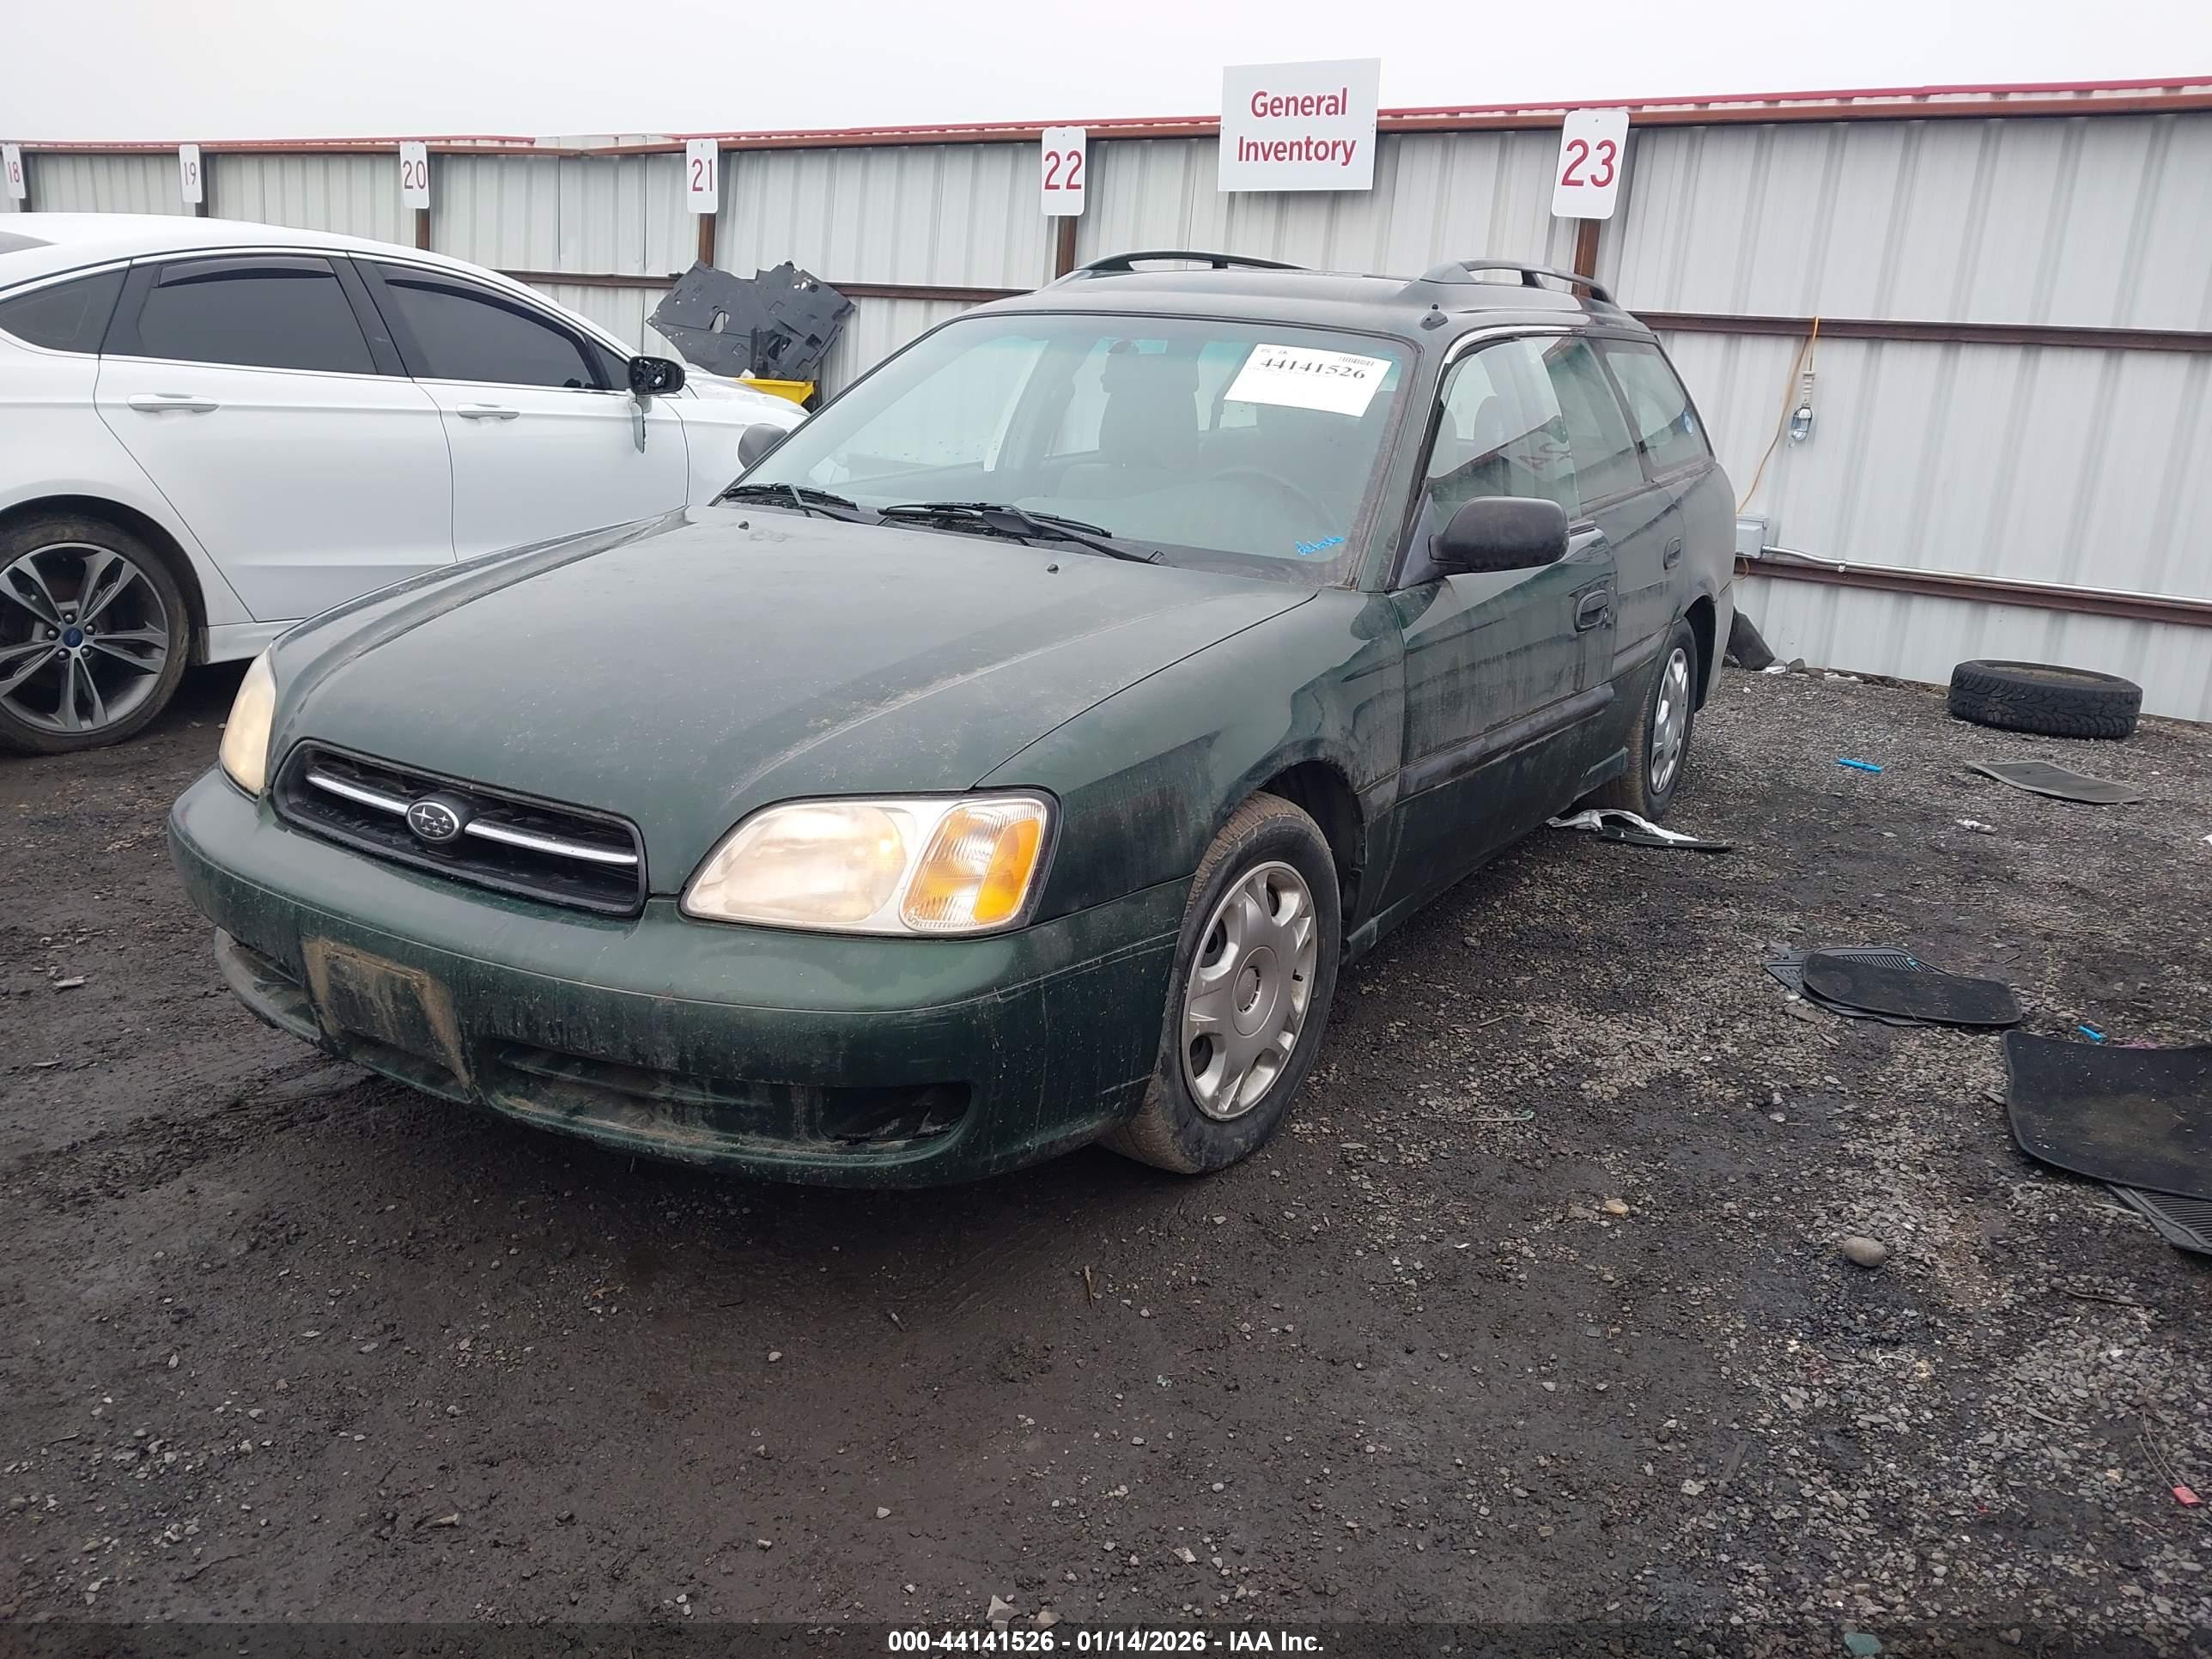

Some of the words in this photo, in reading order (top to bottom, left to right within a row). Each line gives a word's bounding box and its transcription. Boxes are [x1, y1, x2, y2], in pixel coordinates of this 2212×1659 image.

[1250, 87, 1347, 118] General
[1237, 136, 1357, 167] Inventory
[1560, 138, 1617, 188] 23
[7, 161, 21, 184] 18
[184, 161, 197, 186] 19
[402, 160, 427, 190] 20
[691, 158, 714, 192] 21
[1043, 150, 1083, 191] 22
[1260, 357, 1366, 380] 44141526
